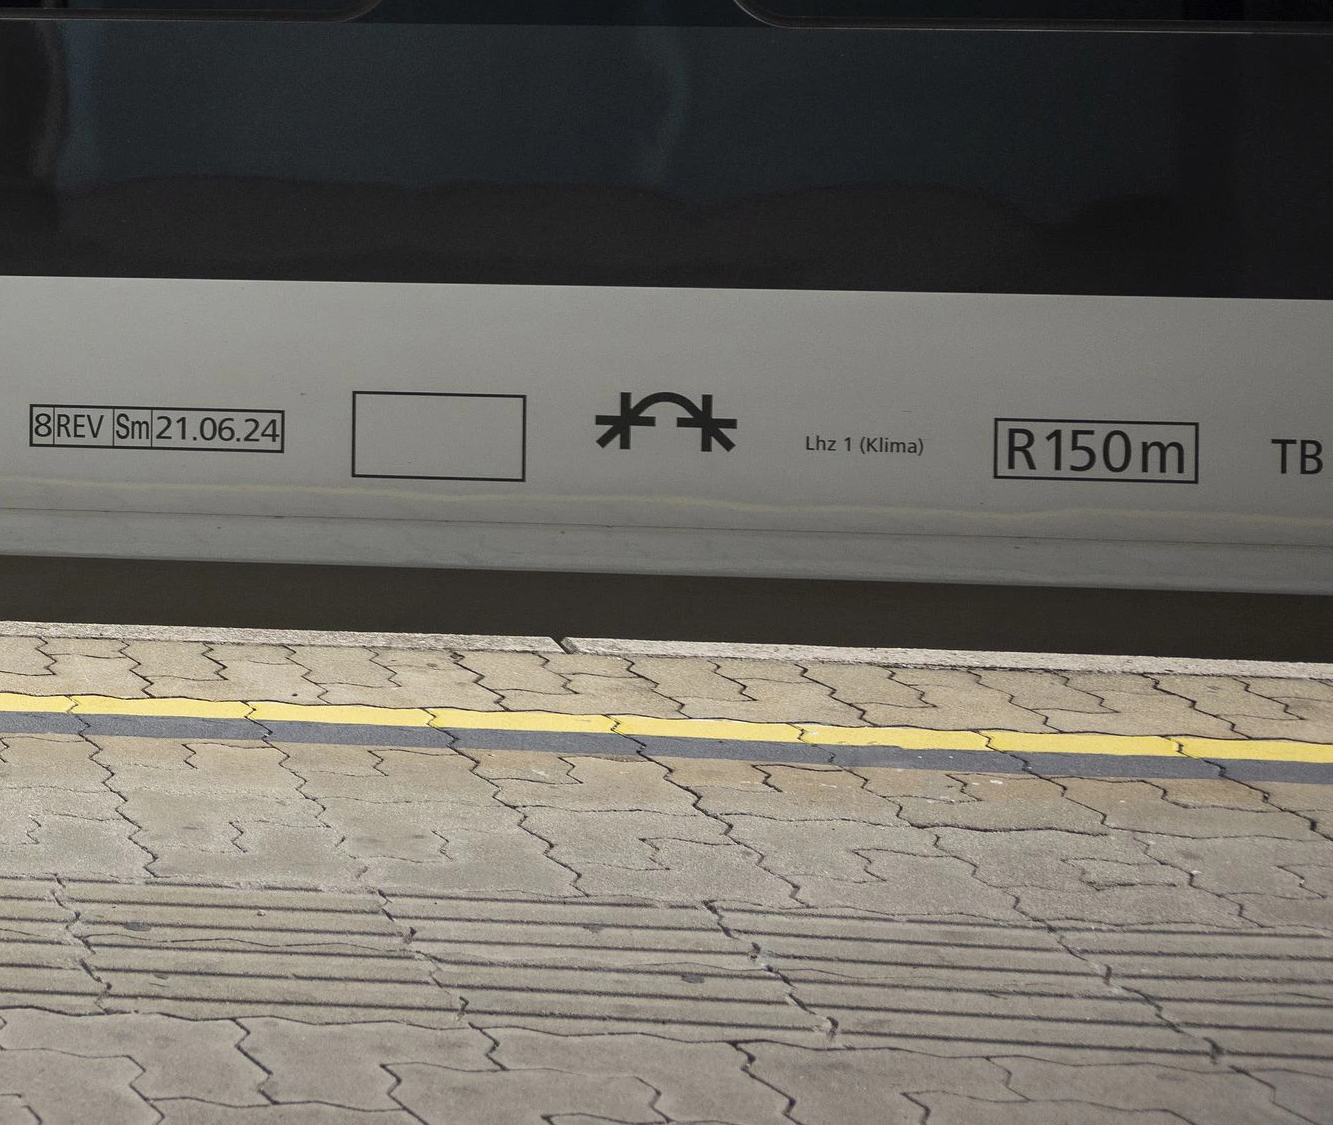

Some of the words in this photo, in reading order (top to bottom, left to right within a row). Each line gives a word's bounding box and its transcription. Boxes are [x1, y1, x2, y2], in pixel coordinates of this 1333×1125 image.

[57, 414, 104, 438] REV
[115, 413, 150, 440] Sm
[155, 415, 280, 443] 21.06.24
[806, 435, 837, 452] Lhz
[844, 437, 851, 452] 1
[860, 436, 924, 456] (Klima)
[1271, 438, 1324, 475] TB
